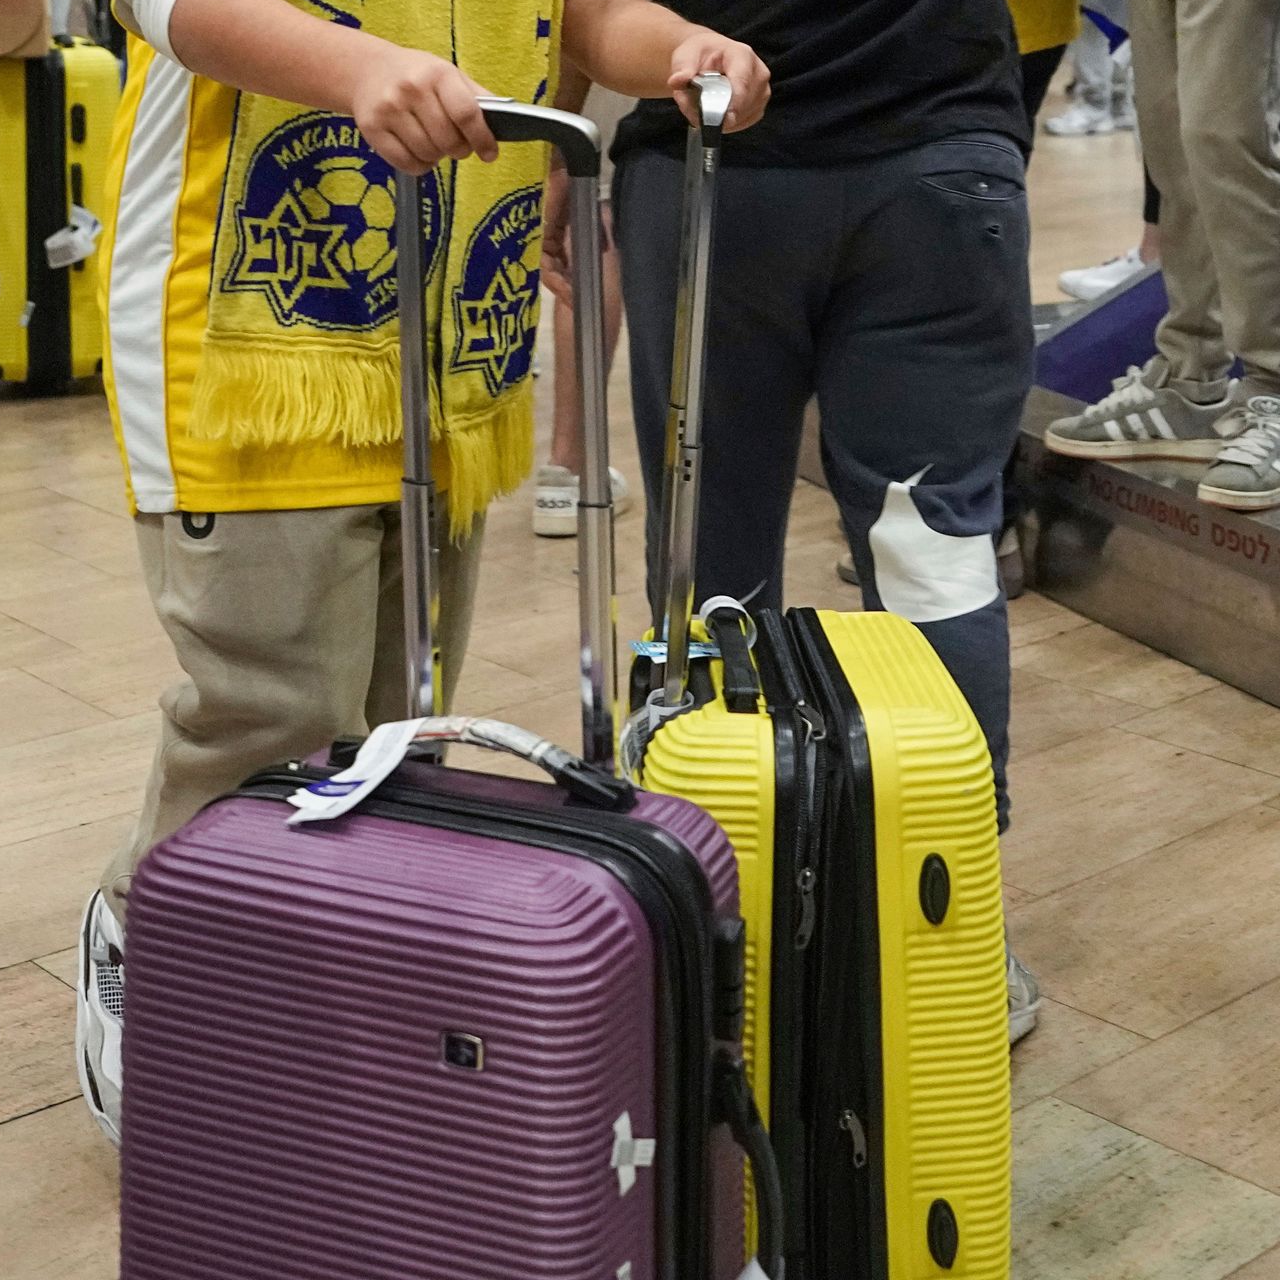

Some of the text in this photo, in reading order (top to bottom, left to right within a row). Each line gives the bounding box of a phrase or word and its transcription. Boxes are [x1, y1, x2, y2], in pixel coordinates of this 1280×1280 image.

[273, 124, 361, 170] MACCABI
[1119, 484, 1201, 537] CLIMBING
[1210, 522, 1271, 565] לטפס
